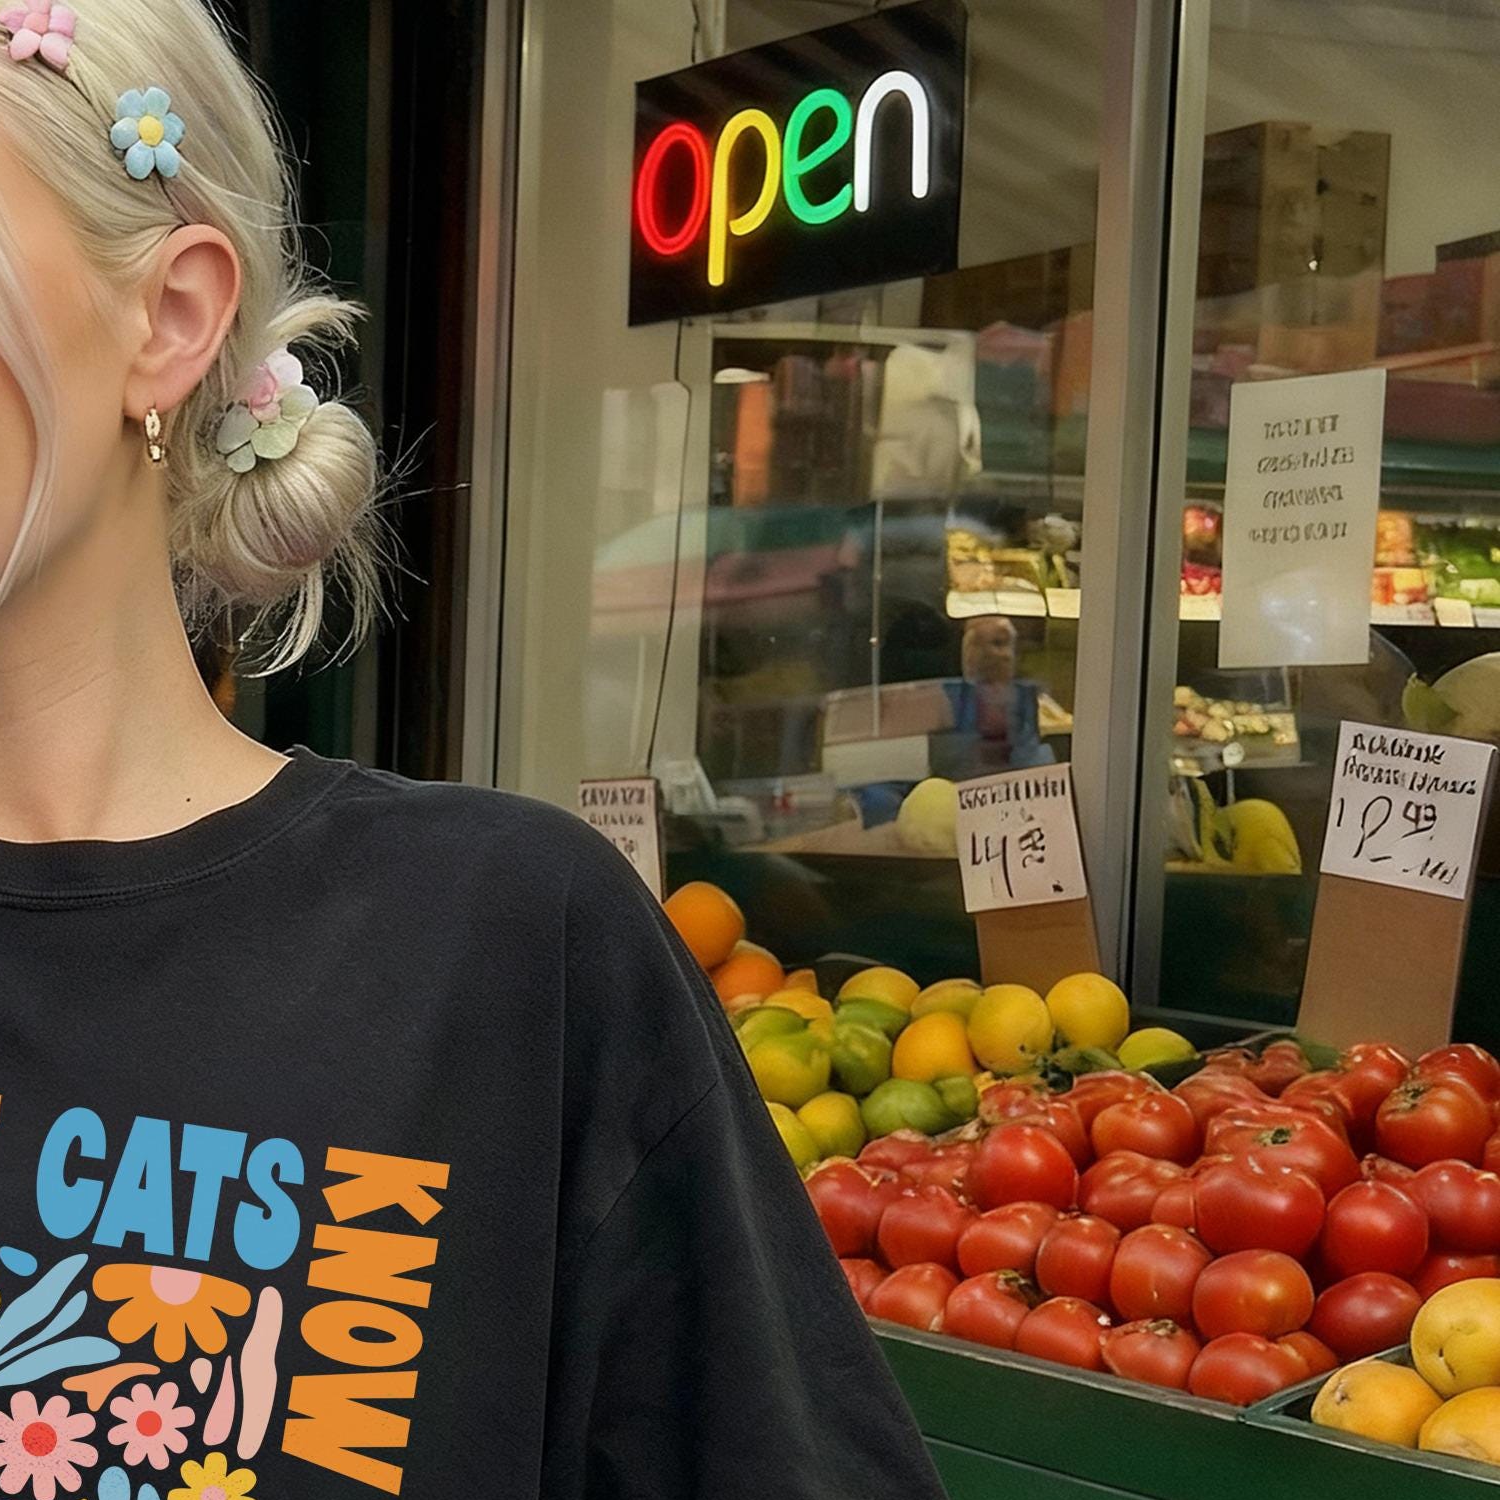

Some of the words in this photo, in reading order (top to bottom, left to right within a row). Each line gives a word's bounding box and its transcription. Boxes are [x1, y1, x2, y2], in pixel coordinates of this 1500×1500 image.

[637, 69, 930, 287] open
[36, 1106, 305, 1271] CATS
[281, 1146, 451, 1497] KNOW
